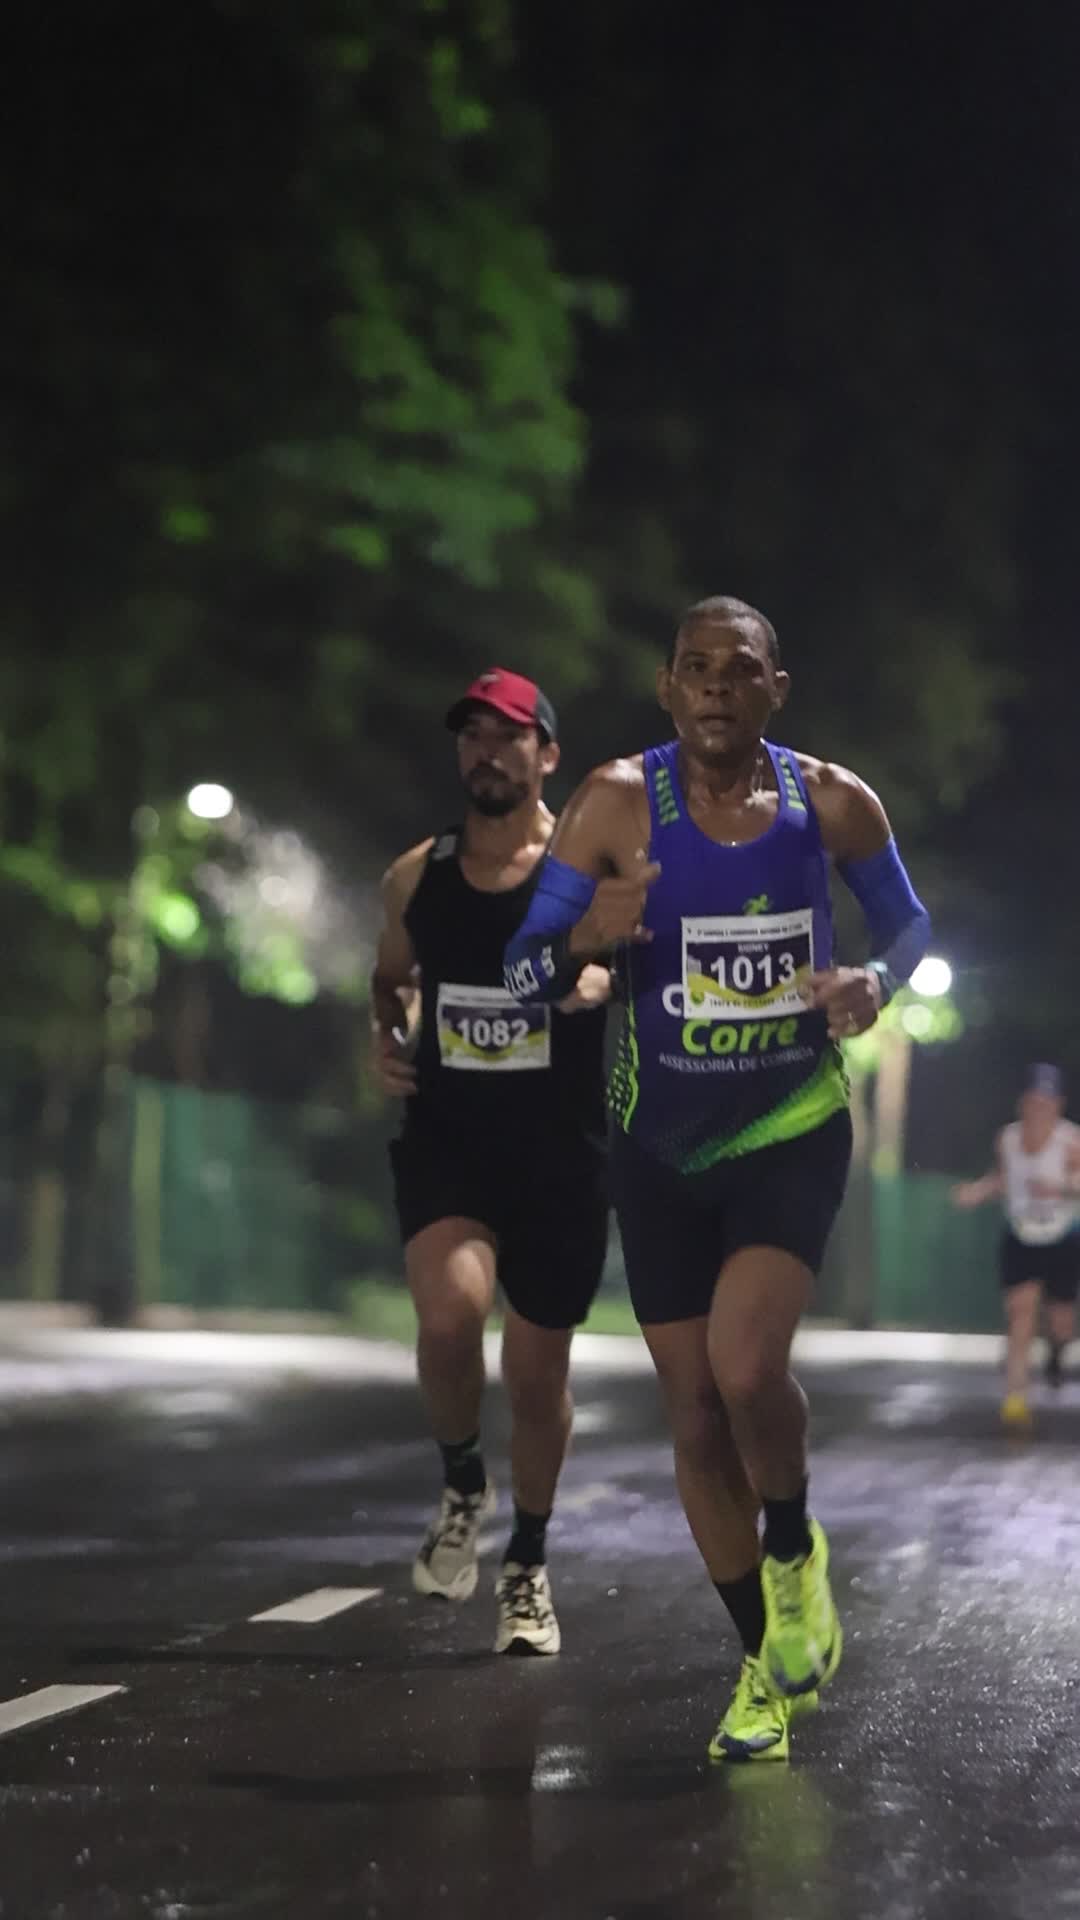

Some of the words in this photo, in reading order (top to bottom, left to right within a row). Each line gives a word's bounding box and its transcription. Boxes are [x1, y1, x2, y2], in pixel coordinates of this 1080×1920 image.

[710, 952, 796, 990] 1013
[456, 1017, 529, 1047] 1082
[681, 1017, 798, 1056] Corre
[658, 1052, 736, 1073] ASSESSORIA
[738, 1057, 757, 1071] DE
